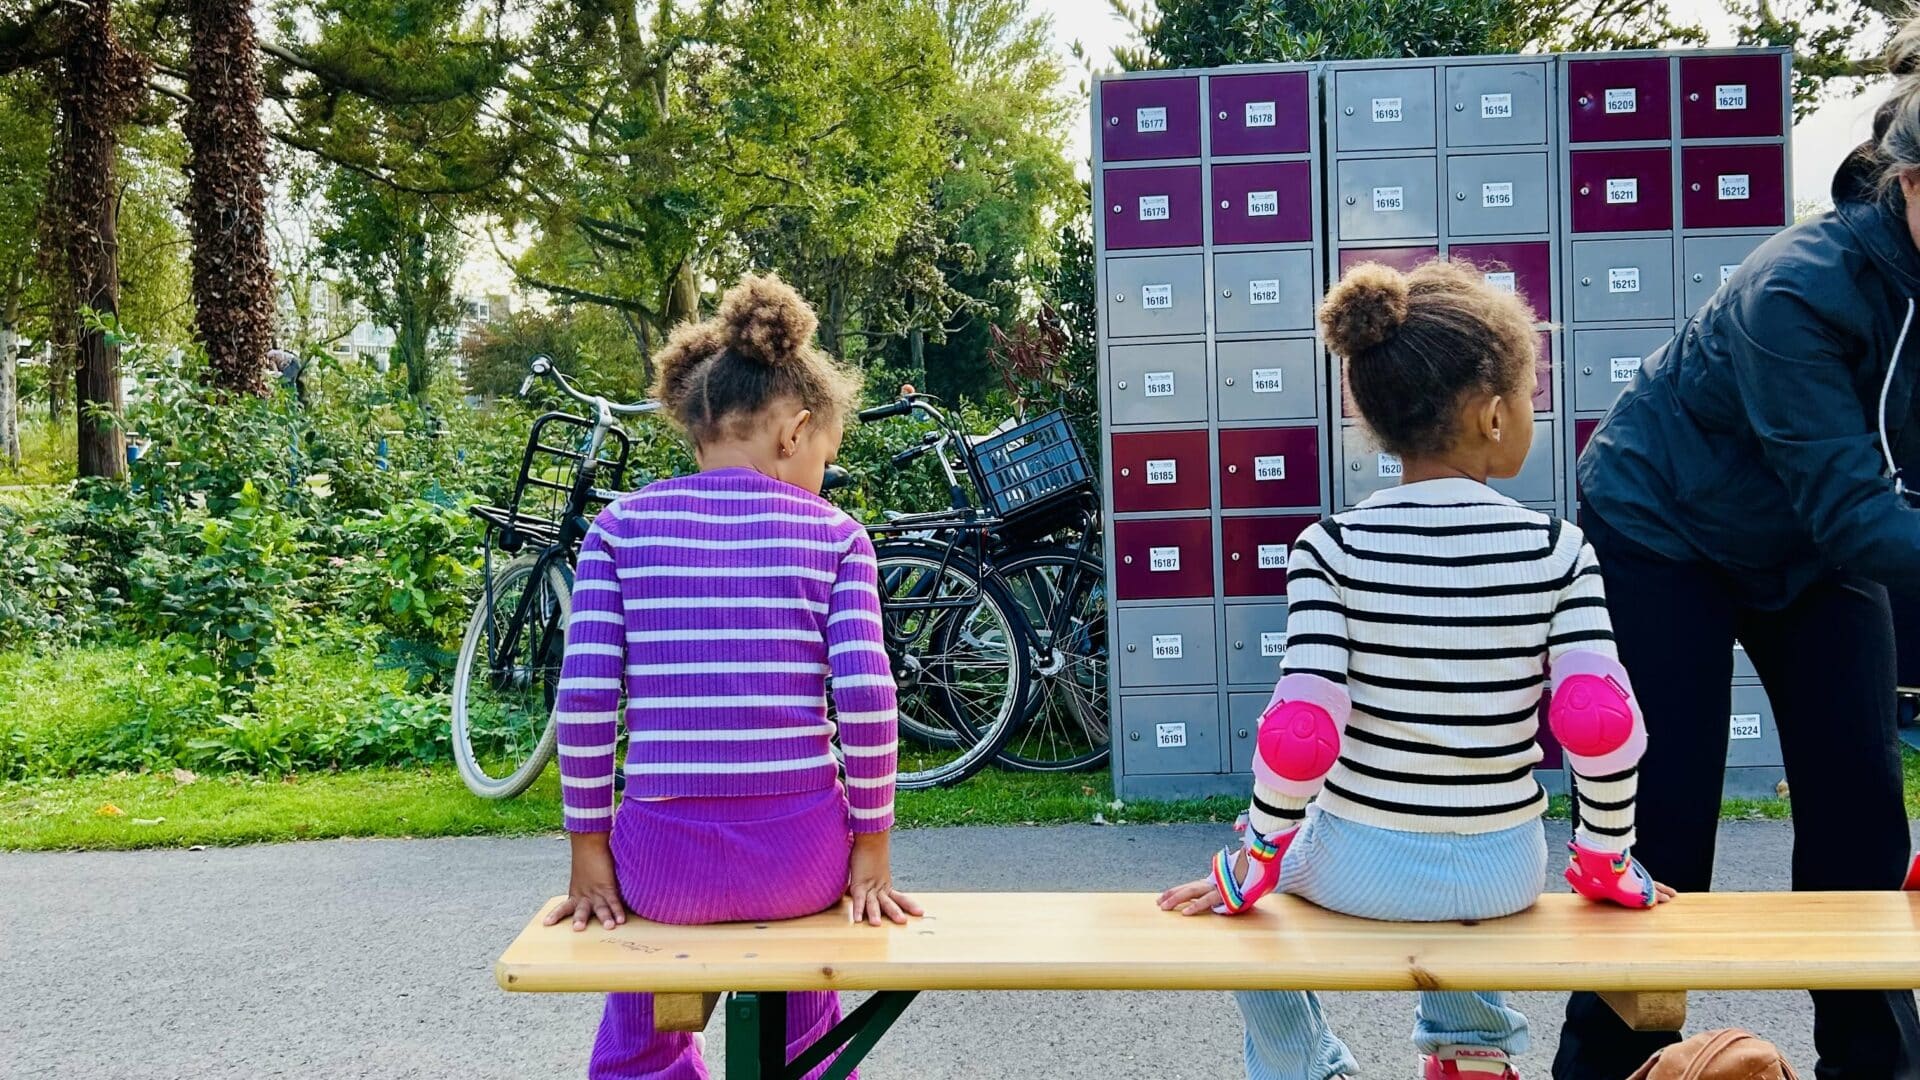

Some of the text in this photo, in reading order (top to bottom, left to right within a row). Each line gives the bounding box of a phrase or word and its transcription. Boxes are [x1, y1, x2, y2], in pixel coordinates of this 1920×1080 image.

[1607, 100, 1634, 110] 16209
[1719, 97, 1744, 107] 16210
[1375, 109, 1399, 119] 16193
[1484, 105, 1509, 115] 16194
[1249, 113, 1273, 124] 16178
[1140, 119, 1164, 129] 16177
[1610, 191, 1634, 201] 16211
[1721, 186, 1746, 196] 16212
[1376, 198, 1401, 208] 16195
[1486, 194, 1510, 204] 16196
[1143, 207, 1166, 217] 16179
[1251, 203, 1275, 213] 16180
[1612, 279, 1636, 289] 16213
[1146, 296, 1169, 306] 16181
[1253, 291, 1277, 301] 16182
[1147, 383, 1172, 394] 16183
[1255, 379, 1279, 390] 16184
[1258, 467, 1282, 477] 16186
[1382, 465, 1402, 474] 1620
[1150, 471, 1174, 481] 16185
[1153, 558, 1177, 568] 16187
[1261, 555, 1285, 565] 16188
[1155, 646, 1180, 656] 16189
[1264, 644, 1287, 653] 16190
[1732, 725, 1758, 736] 16224
[1160, 734, 1183, 744] 16191
